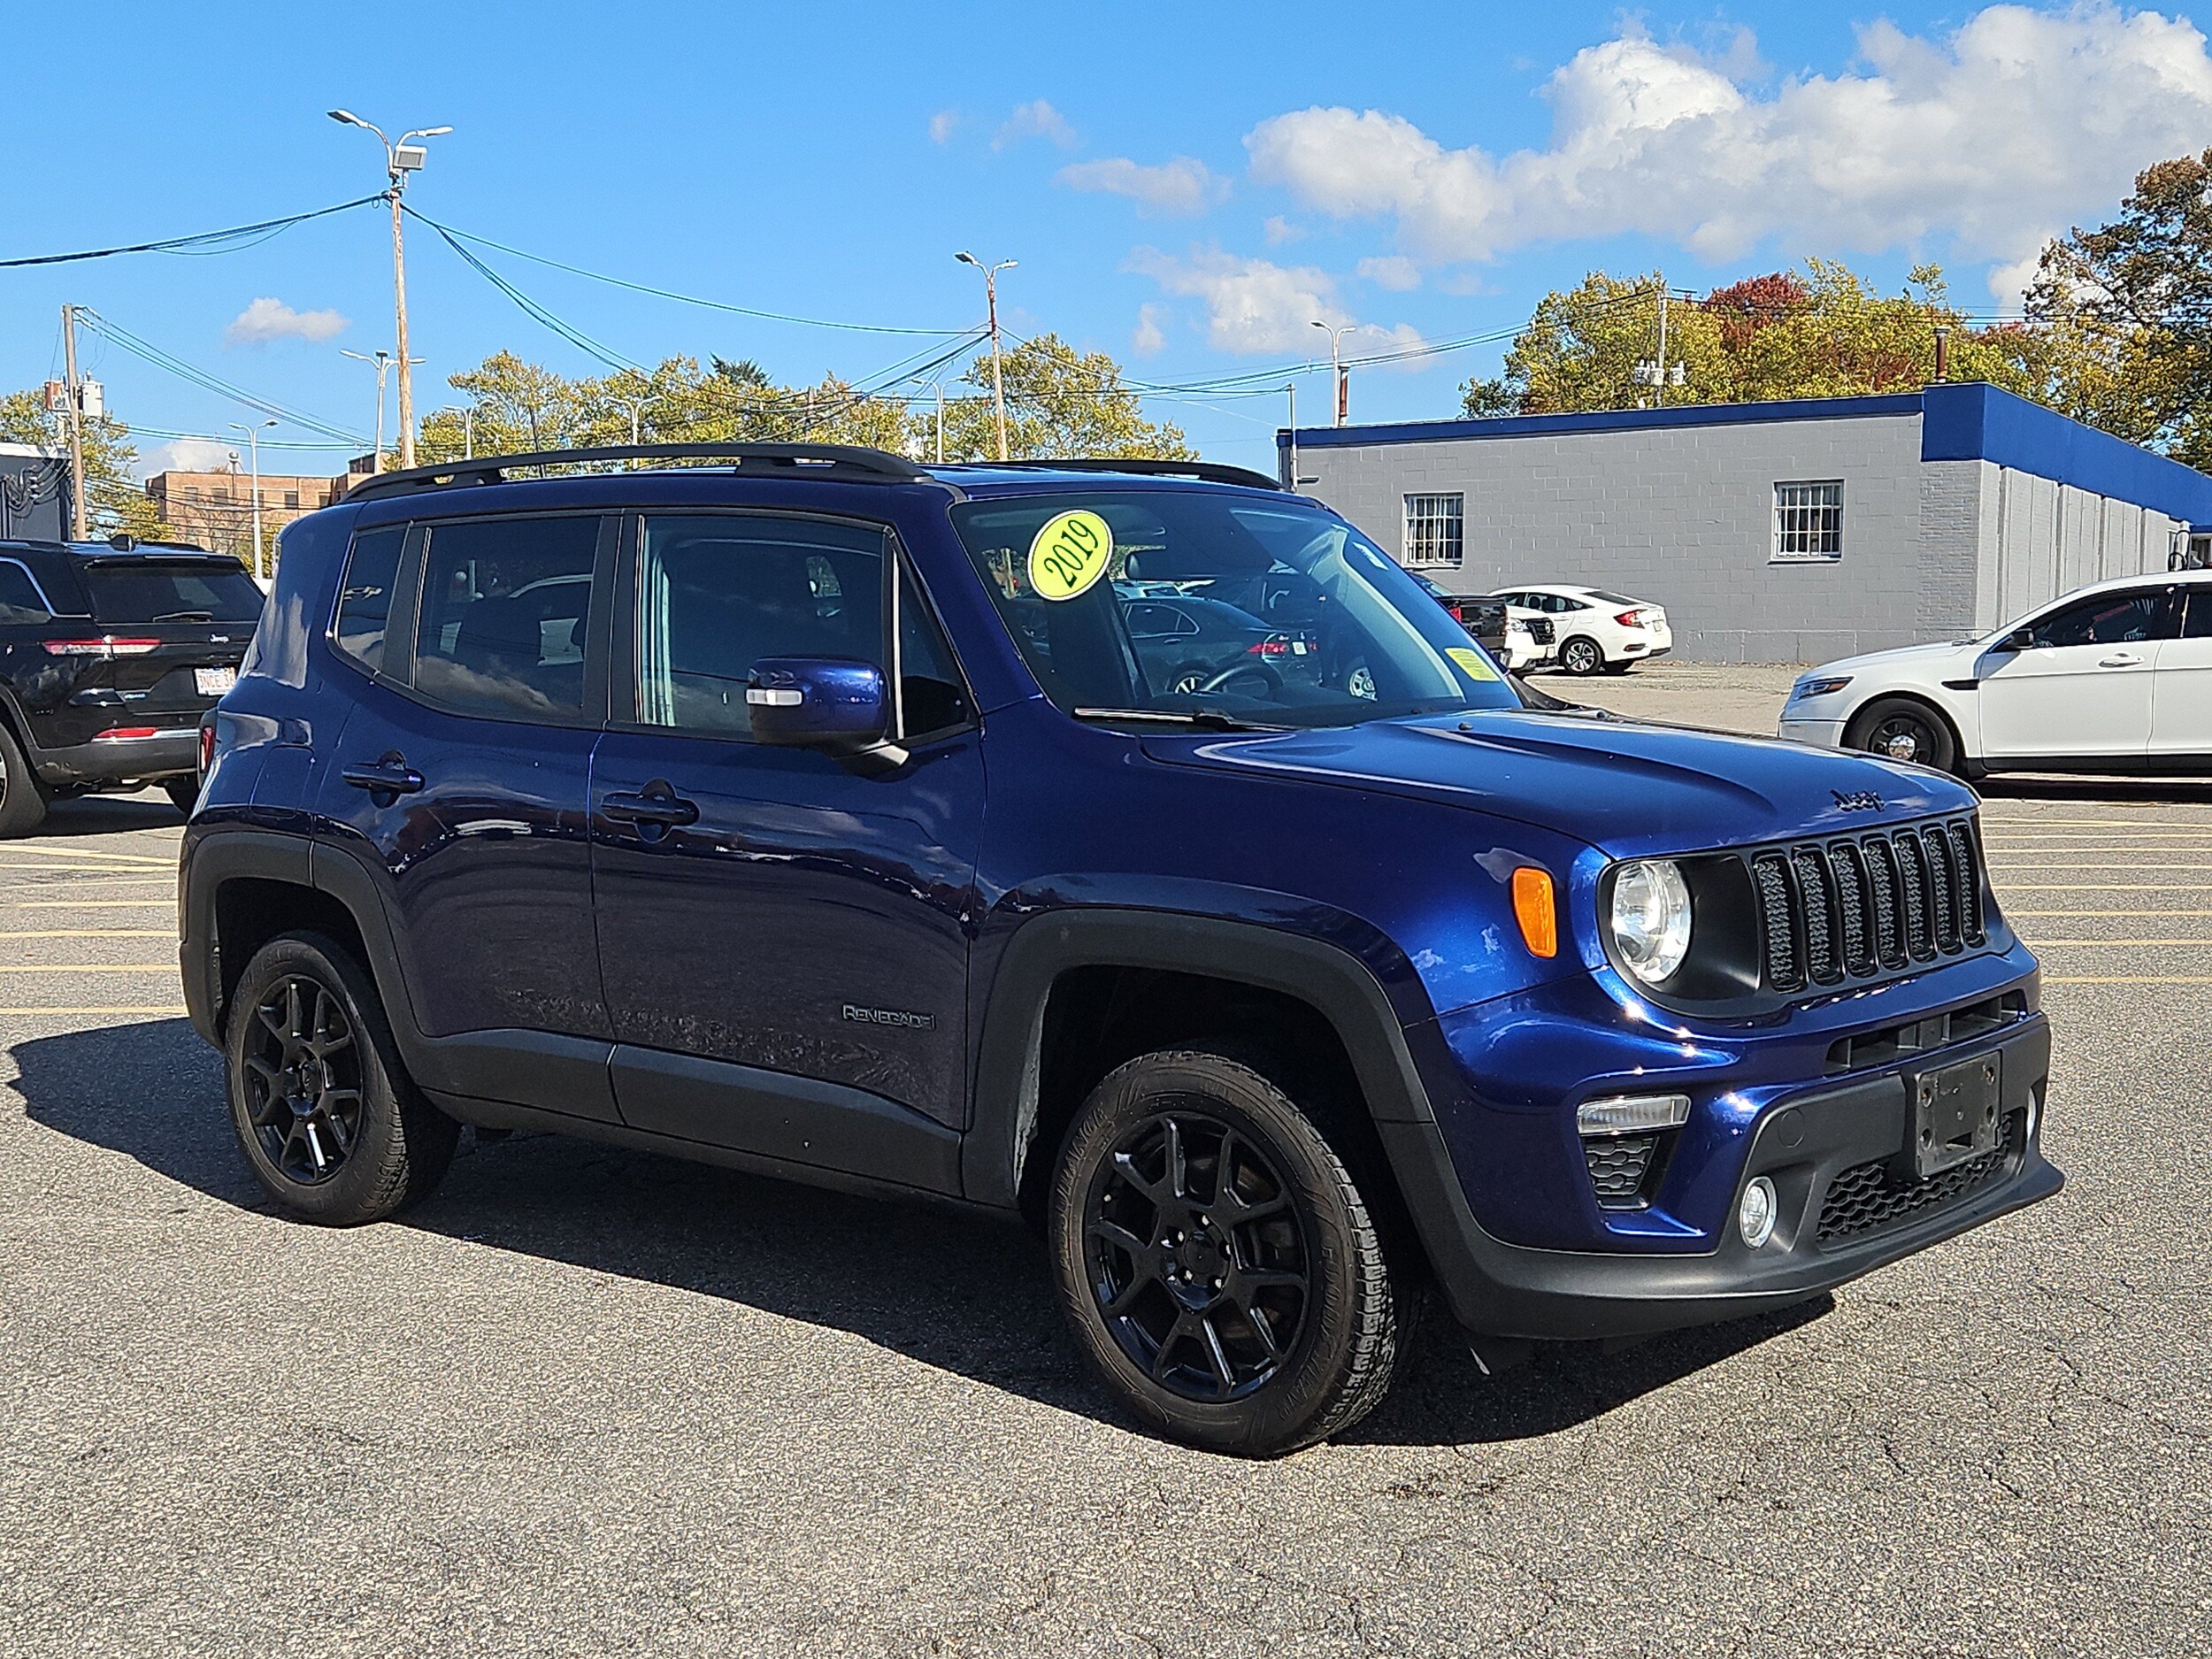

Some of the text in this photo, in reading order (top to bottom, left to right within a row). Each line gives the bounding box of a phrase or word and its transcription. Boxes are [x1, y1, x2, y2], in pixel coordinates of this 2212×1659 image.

[1044, 519, 1098, 588] 2019
[1829, 787, 1886, 813] Jeep
[842, 1003, 936, 1031] RENEGADE
